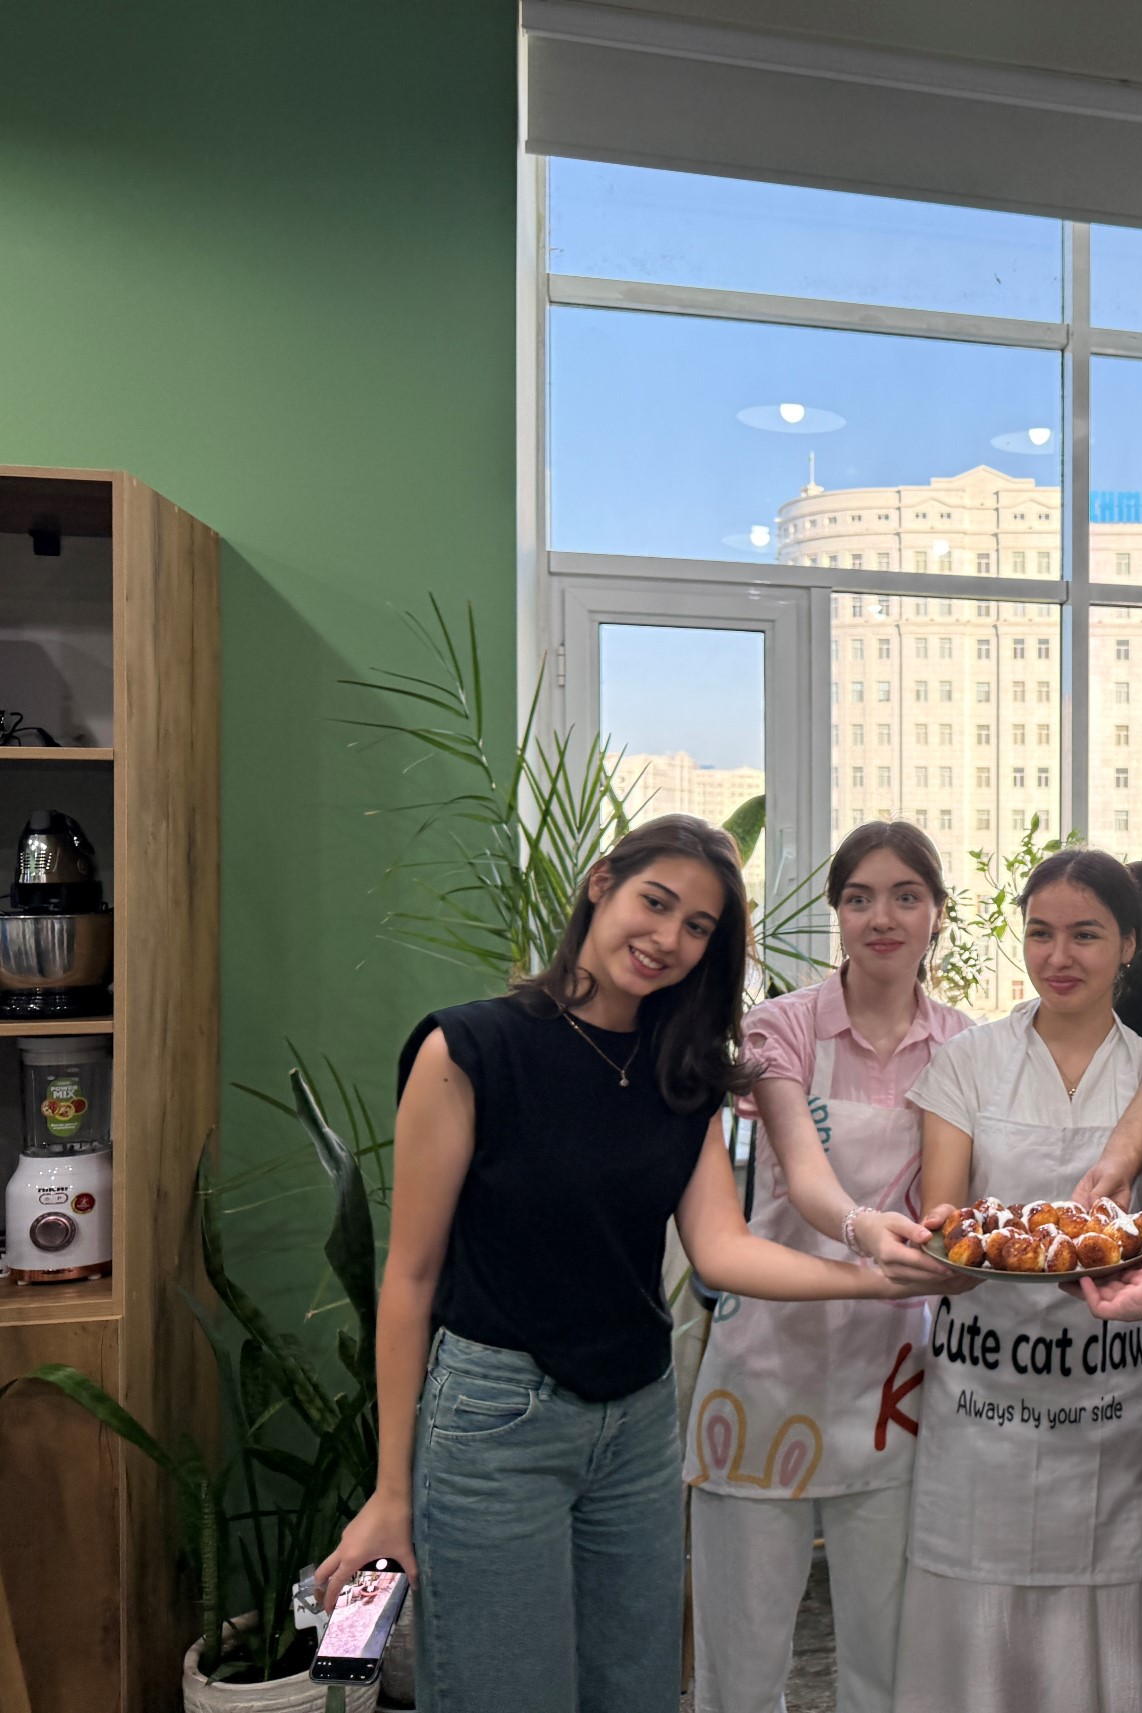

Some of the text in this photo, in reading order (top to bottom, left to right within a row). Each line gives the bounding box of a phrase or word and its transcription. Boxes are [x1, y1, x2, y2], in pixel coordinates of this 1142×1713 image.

[931, 1296, 1001, 1370] Cute
[1011, 1327, 1073, 1377] cat
[956, 1389, 1123, 1430] Always by your side
